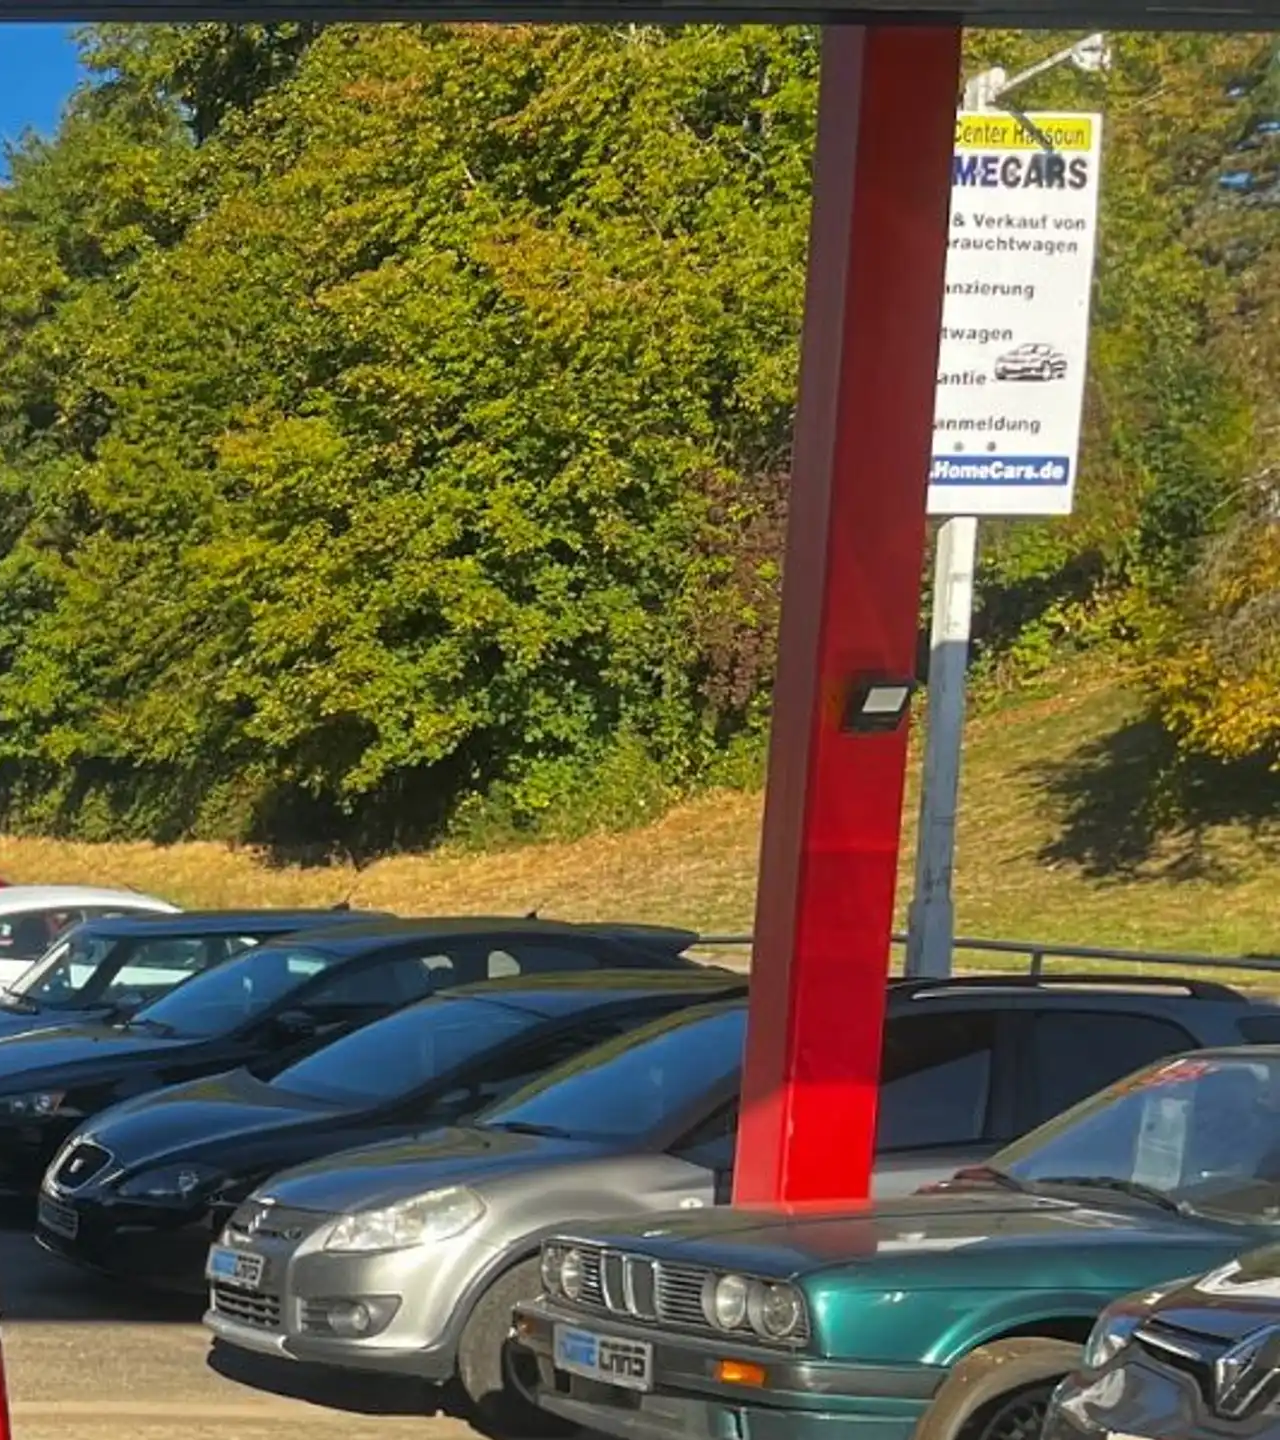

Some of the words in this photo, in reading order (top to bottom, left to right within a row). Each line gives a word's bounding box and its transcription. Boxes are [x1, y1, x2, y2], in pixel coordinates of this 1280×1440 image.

[973, 213, 1047, 230] Verkauf
[1053, 216, 1087, 231] von
[947, 235, 1079, 256] rauchtwagen
